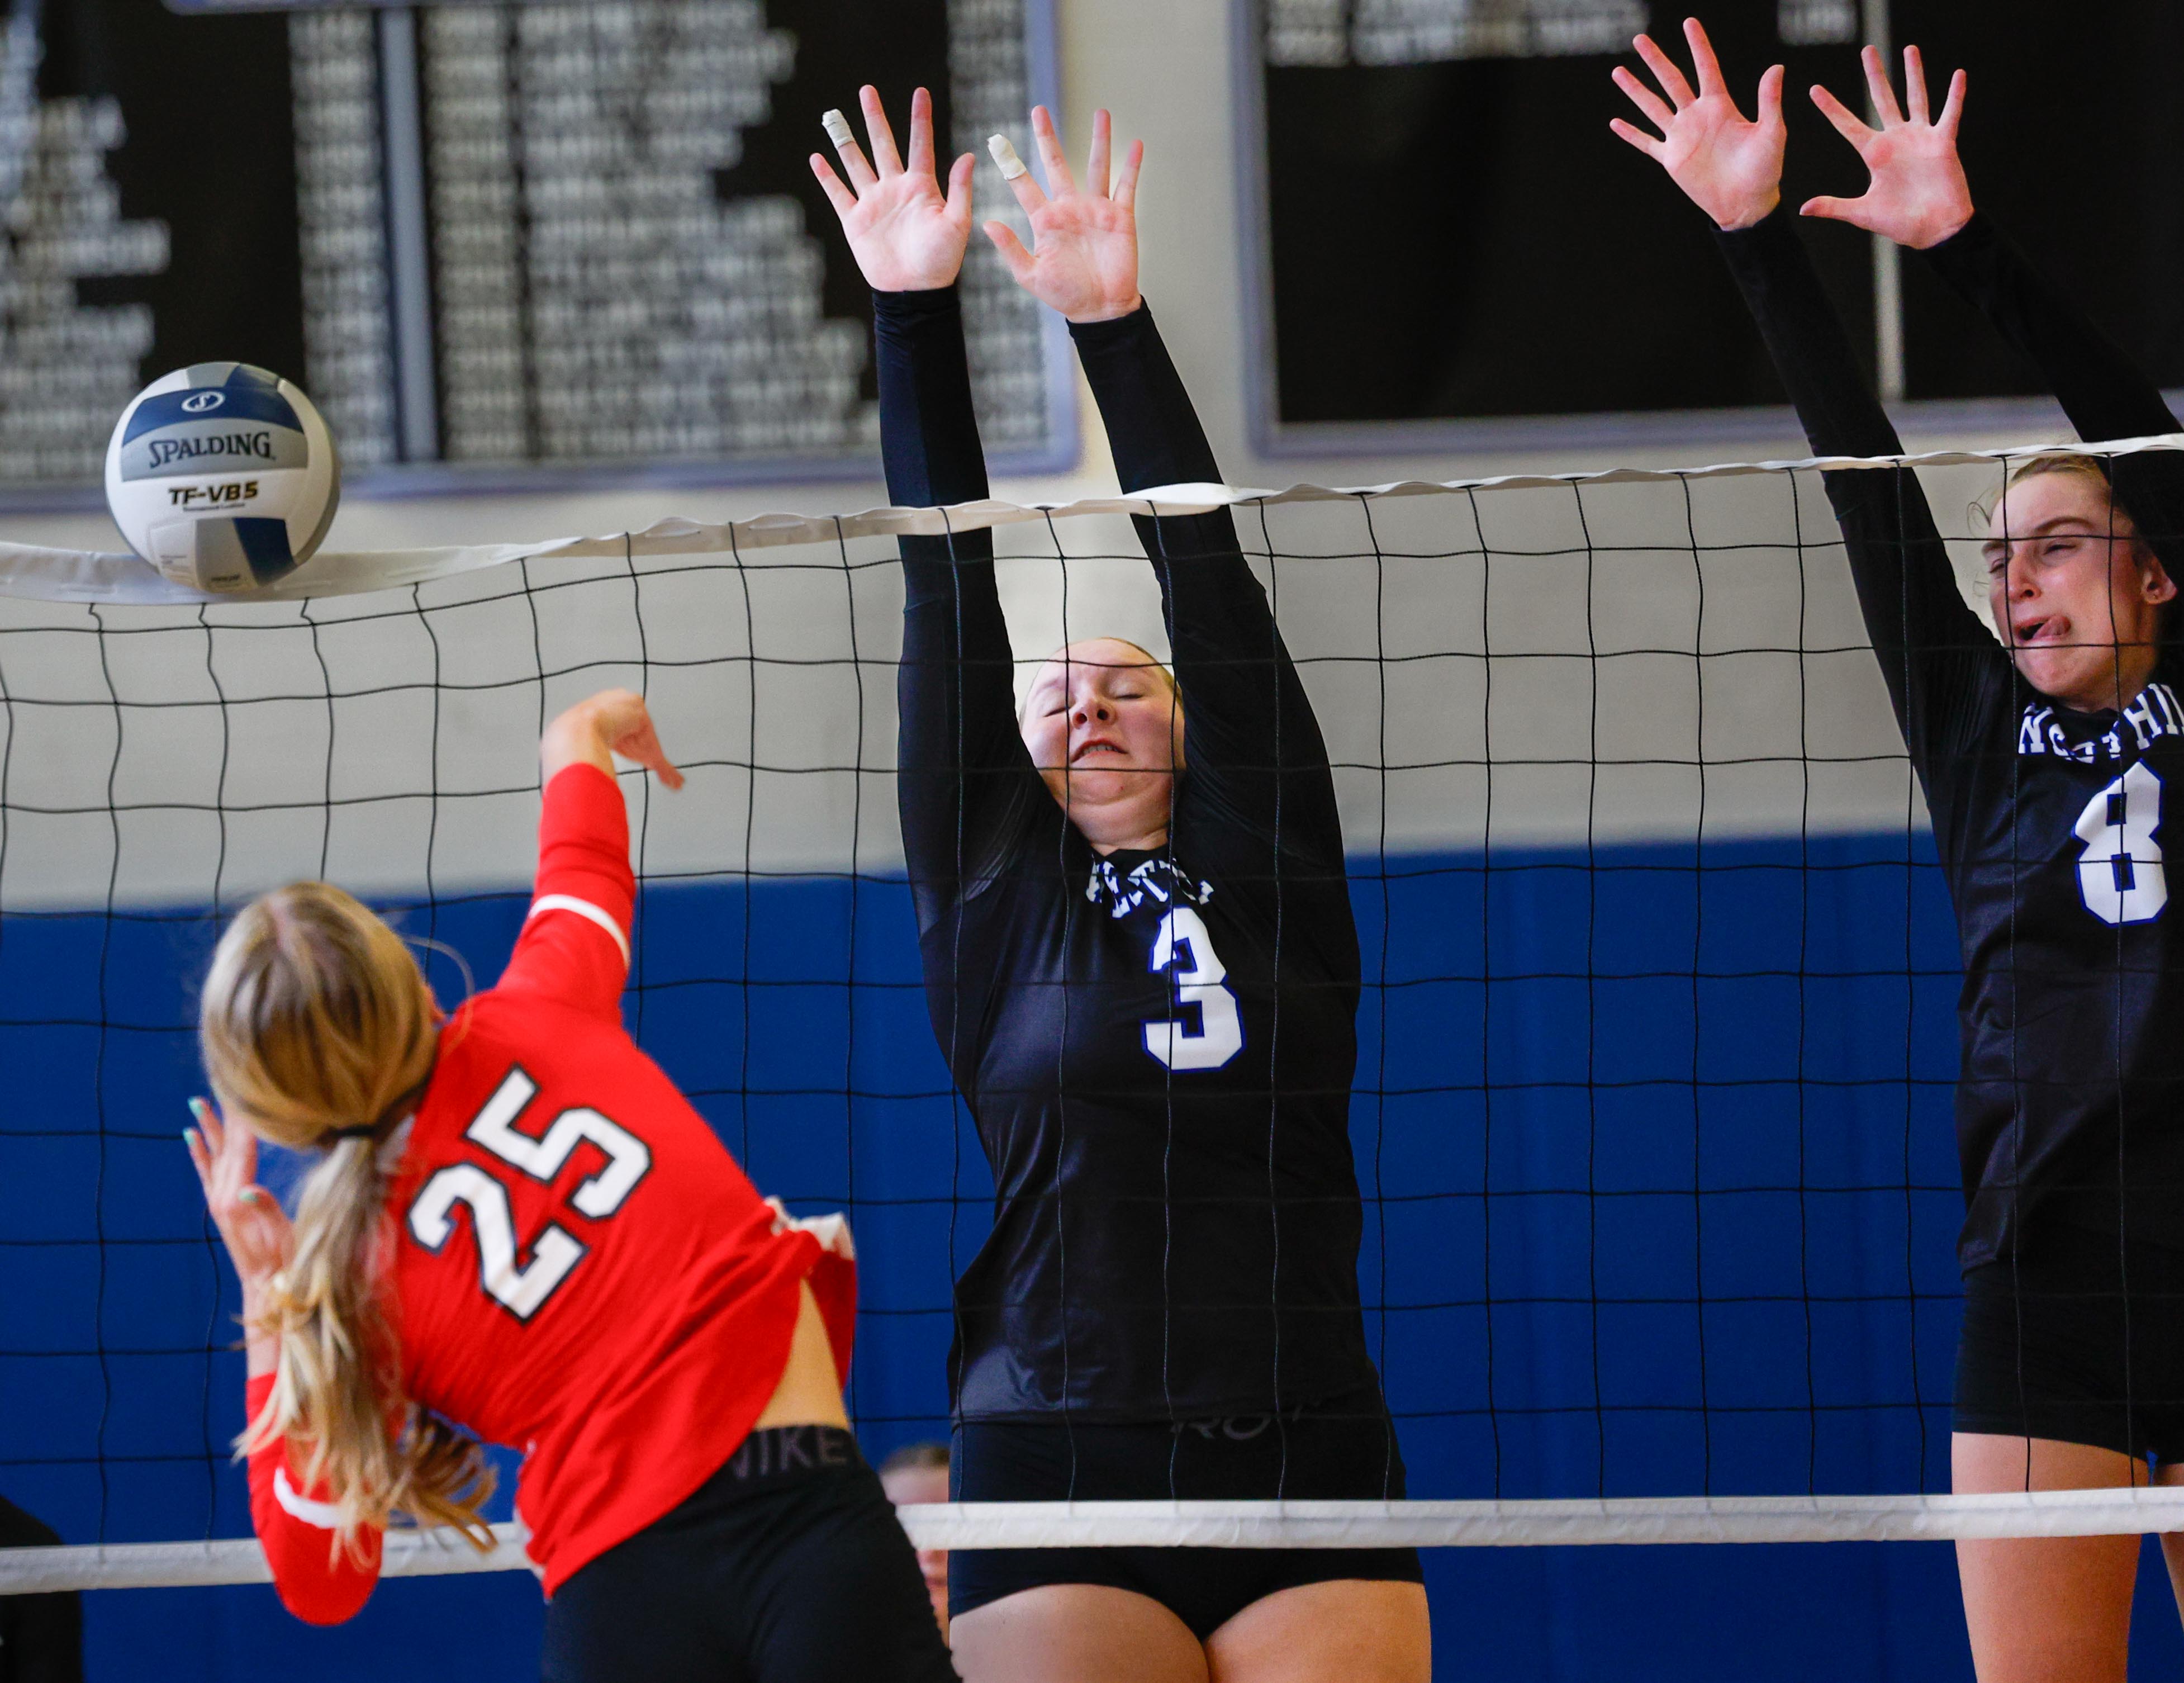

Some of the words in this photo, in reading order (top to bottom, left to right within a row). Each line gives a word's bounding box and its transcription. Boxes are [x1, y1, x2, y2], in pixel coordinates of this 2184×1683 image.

[149, 432, 270, 469] SPALDING
[169, 481, 259, 505] TF-VB5
[2071, 758, 2168, 928] 8
[1140, 904, 1247, 1073] 3
[407, 1062, 653, 1326] 25
